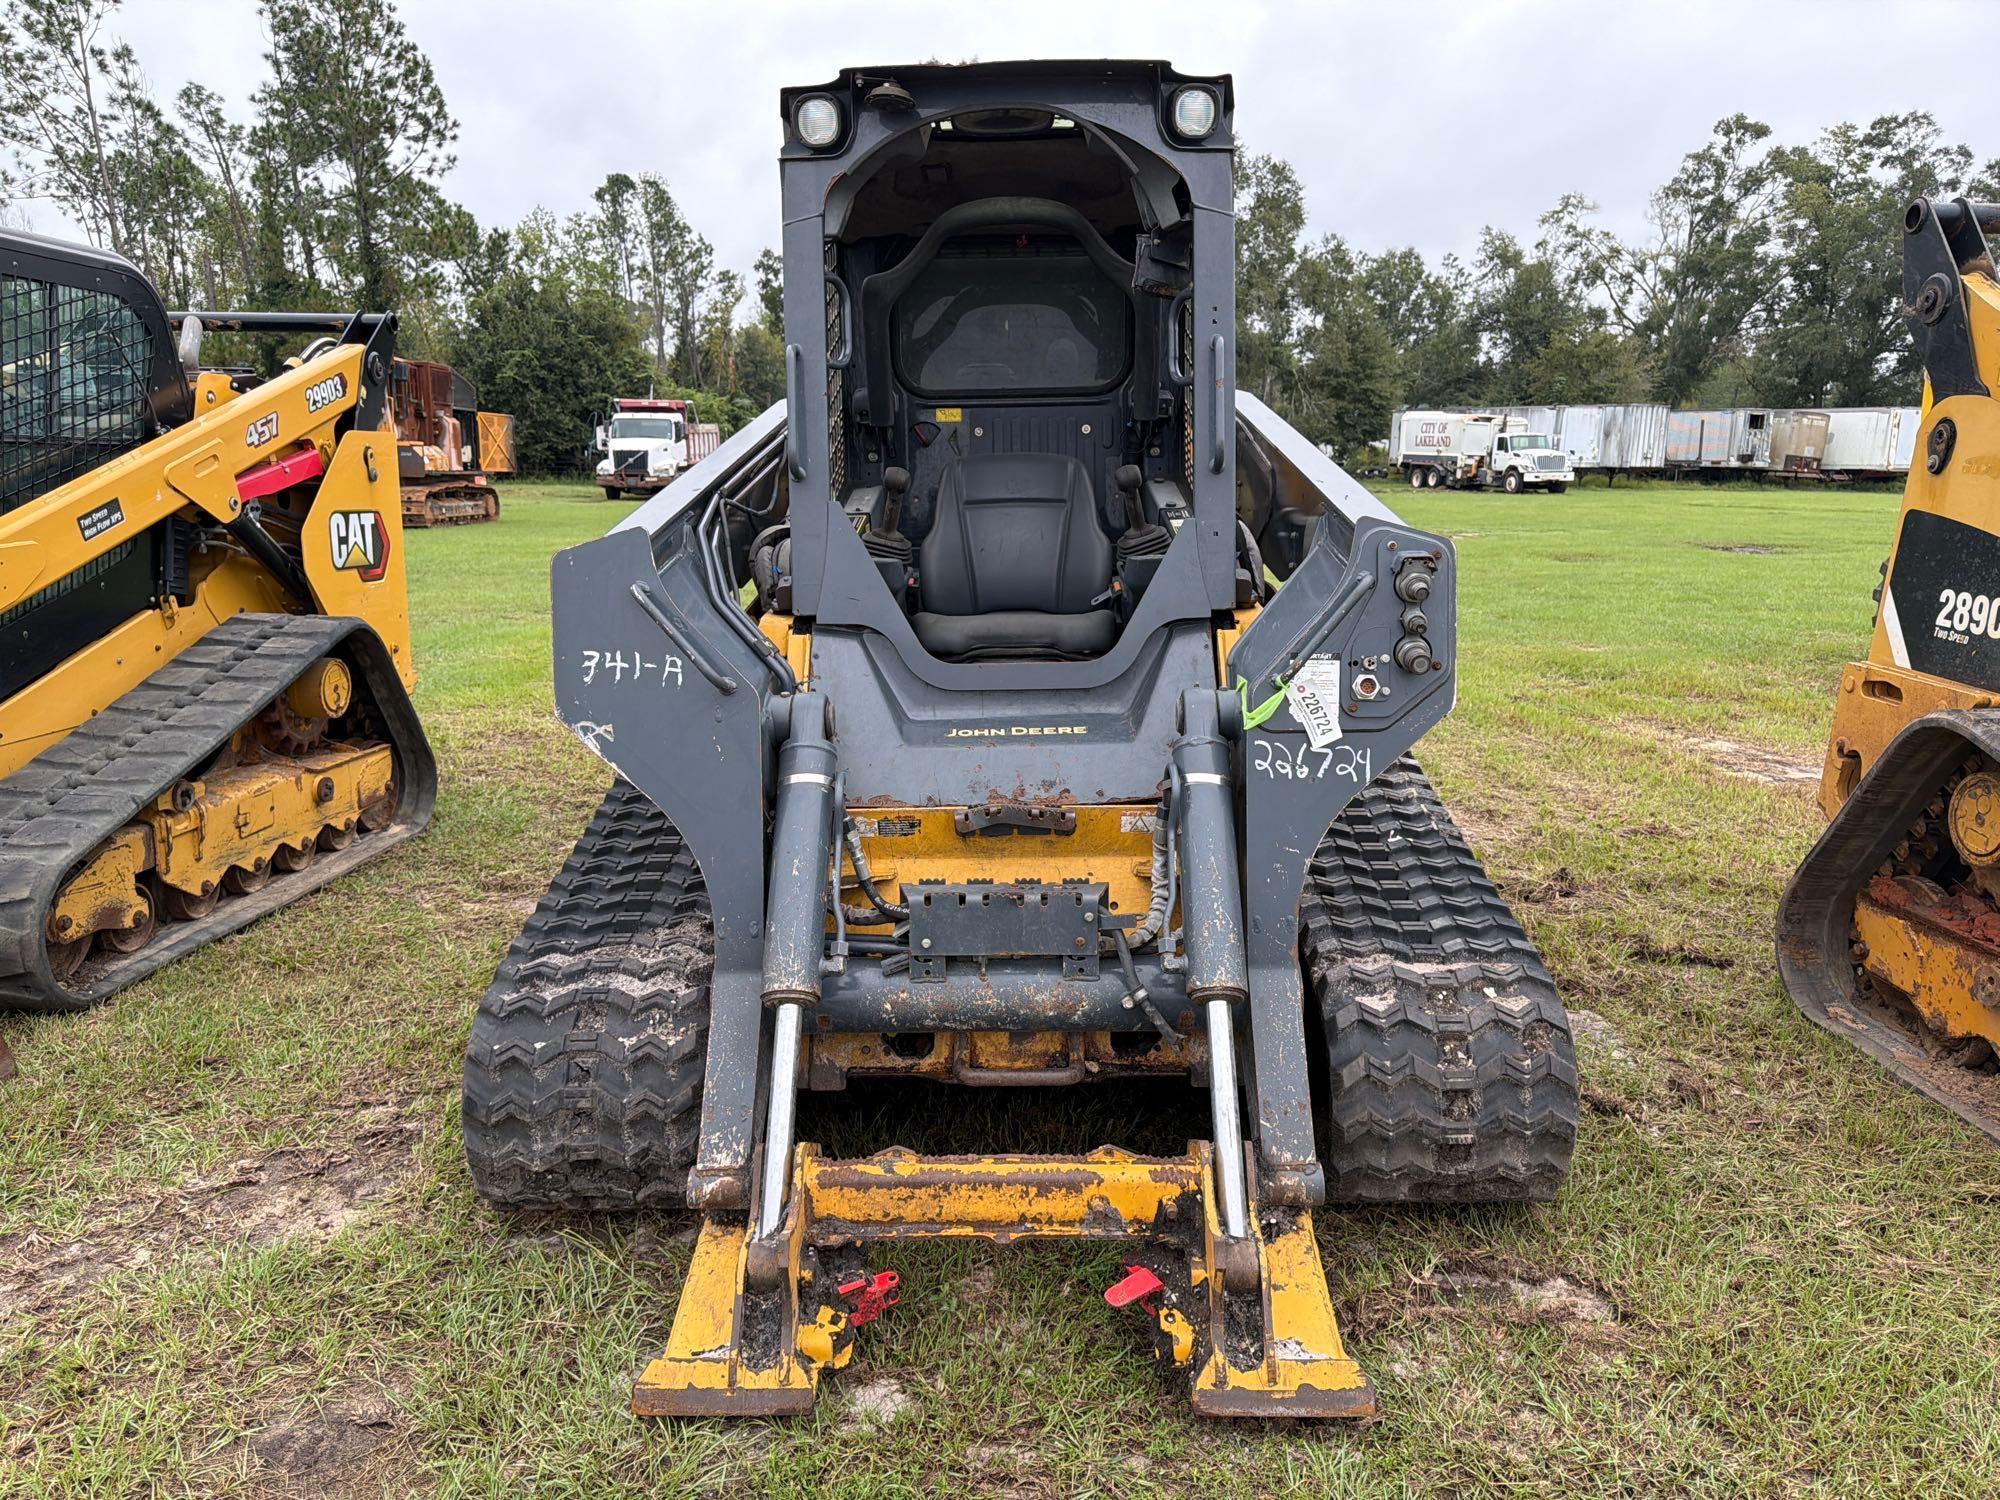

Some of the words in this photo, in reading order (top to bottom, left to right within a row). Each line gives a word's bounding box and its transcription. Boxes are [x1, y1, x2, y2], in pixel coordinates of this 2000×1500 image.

[305, 374, 344, 414] 299D3
[245, 411, 279, 449] 457
[1415, 435, 1451, 448] LAKELAND
[1421, 422, 1437, 434] CITY
[1438, 422, 1448, 434] OF
[330, 512, 375, 569] CAT
[581, 649, 683, 688] 341-A
[946, 728, 1006, 738] JOHN
[1011, 725, 1088, 736] DEERE
[1301, 692, 1334, 736] 226724
[1254, 740, 1371, 783] 226724
